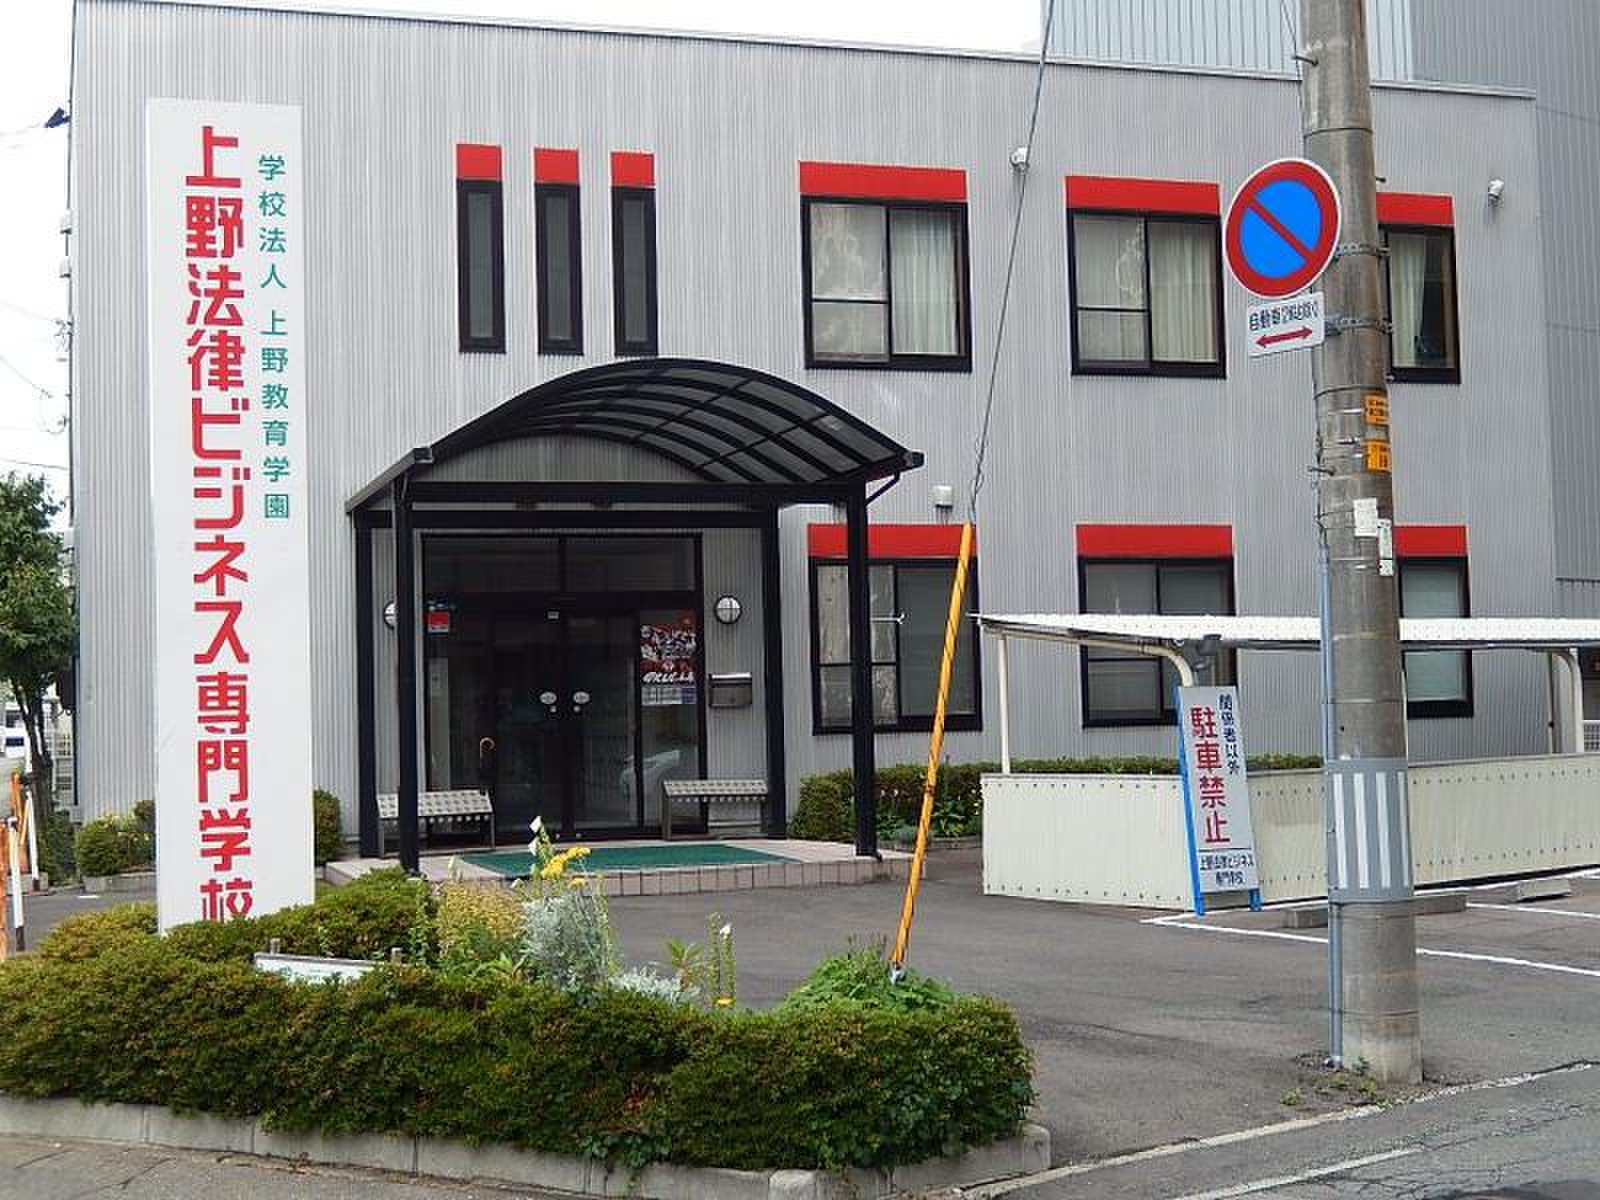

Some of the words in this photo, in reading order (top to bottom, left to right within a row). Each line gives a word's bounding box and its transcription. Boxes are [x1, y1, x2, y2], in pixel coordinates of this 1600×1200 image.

[258, 154, 287, 289] 学校法人
[261, 309, 290, 519] 上野教育学園
[186, 125, 253, 922] 上野法律ビジネス専門学校
[1191, 707, 1230, 843] 駐車禁止
[1219, 694, 1240, 775] 関係者以外
